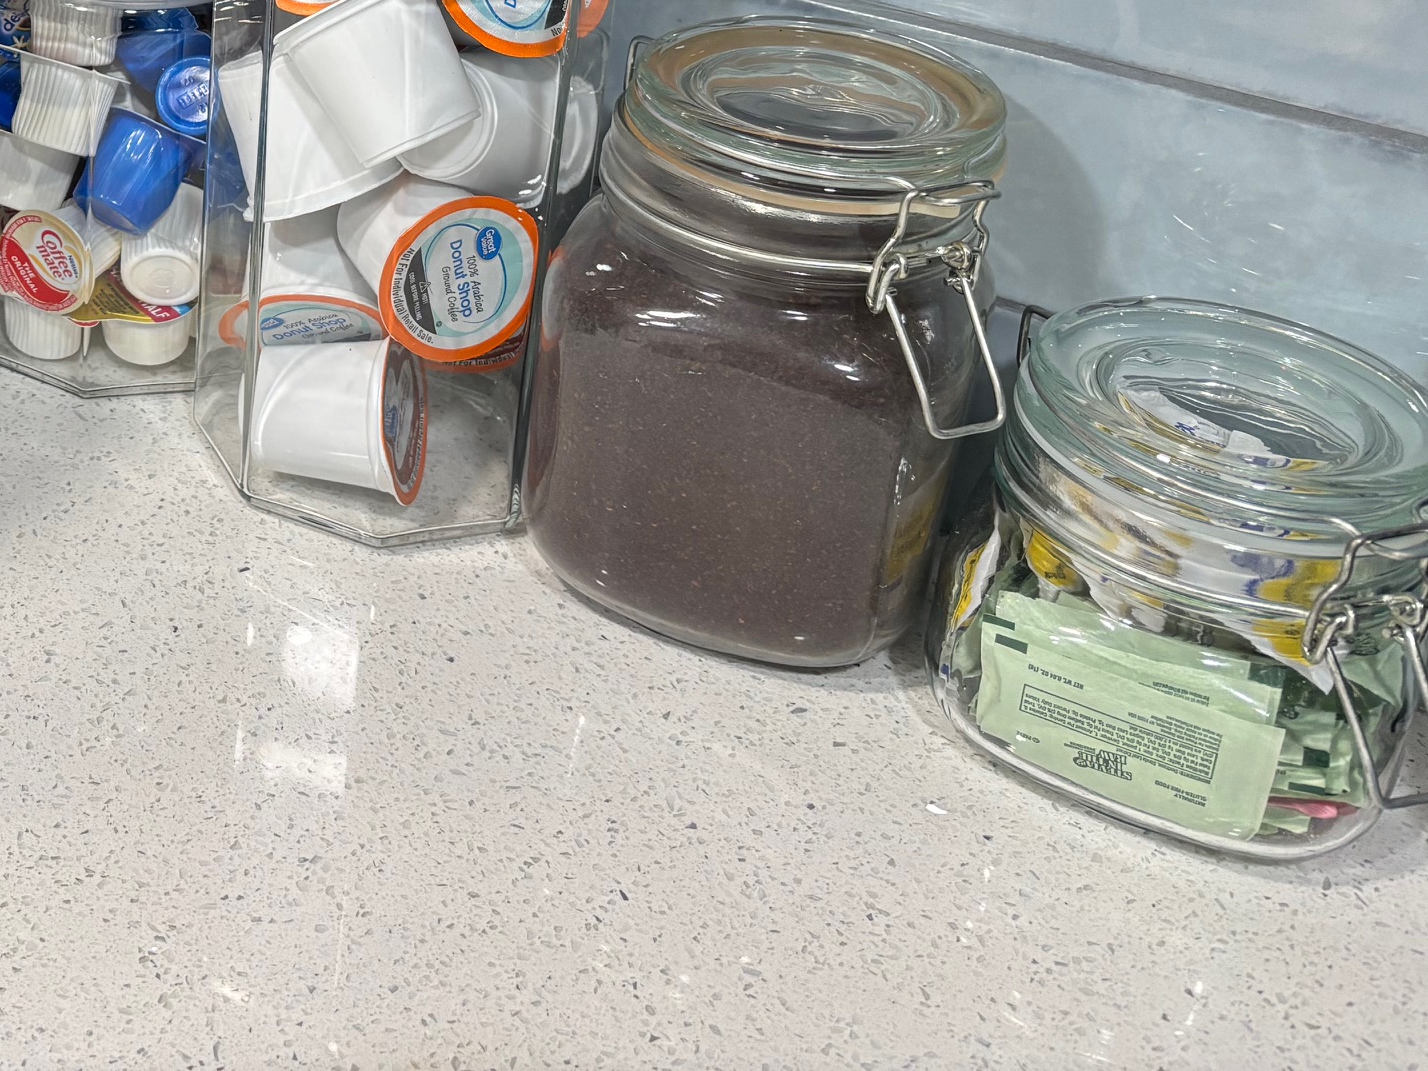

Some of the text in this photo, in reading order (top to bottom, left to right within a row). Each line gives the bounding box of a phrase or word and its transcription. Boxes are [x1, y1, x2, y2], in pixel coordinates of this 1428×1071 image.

[36, 245, 63, 280] mate
[41, 230, 73, 278] Coffee
[486, 229, 496, 253] Great
[11, 255, 38, 293] ORIGINAL
[23, 262, 35, 279] THE
[450, 239, 472, 318] Donut Shop
[467, 255, 483, 313] 100% Arabica
[392, 248, 434, 344] Not For Individual Retail Sale.
[442, 266, 462, 322] Ground Coffee
[272, 318, 346, 340] Donut Shop
